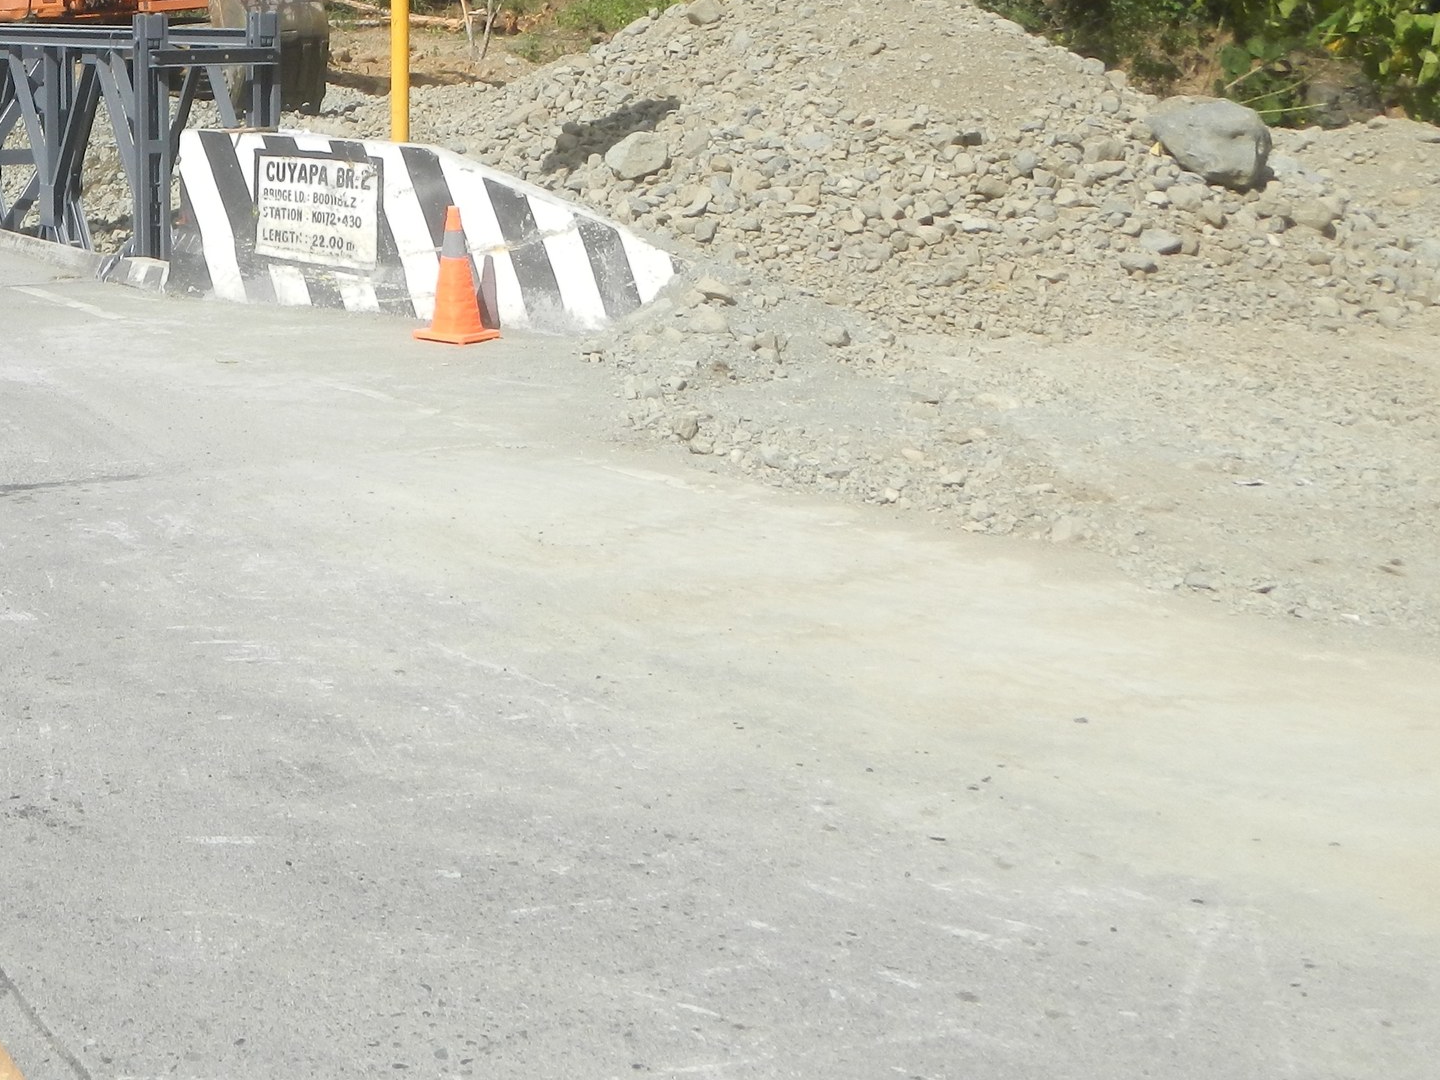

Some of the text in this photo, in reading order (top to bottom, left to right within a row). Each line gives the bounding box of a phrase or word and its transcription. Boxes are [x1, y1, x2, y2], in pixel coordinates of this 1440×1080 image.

[266, 161, 329, 187] CUYAPA
[263, 187, 292, 202] BRIDGE
[263, 206, 303, 222] STATION
[311, 234, 344, 250] 22.00
